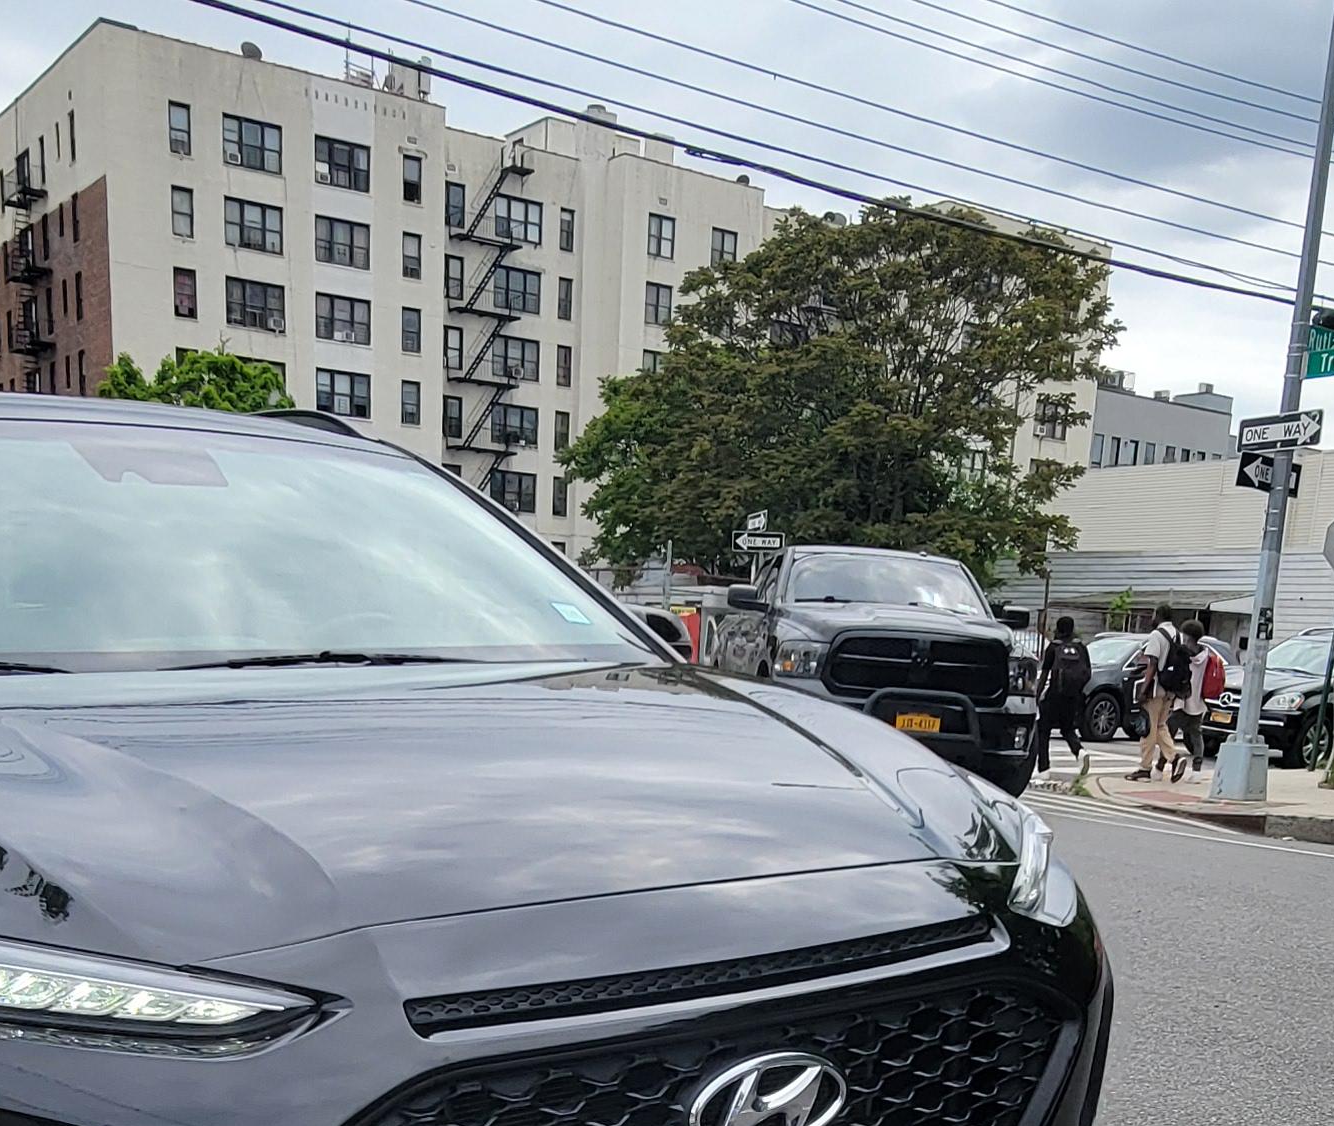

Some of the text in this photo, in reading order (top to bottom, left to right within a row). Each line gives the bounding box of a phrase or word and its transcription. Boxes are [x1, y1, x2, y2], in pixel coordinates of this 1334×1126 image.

[1245, 421, 1311, 442] ONE WAY
[1254, 464, 1271, 481] ONE
[742, 538, 777, 547] ONE WAY
